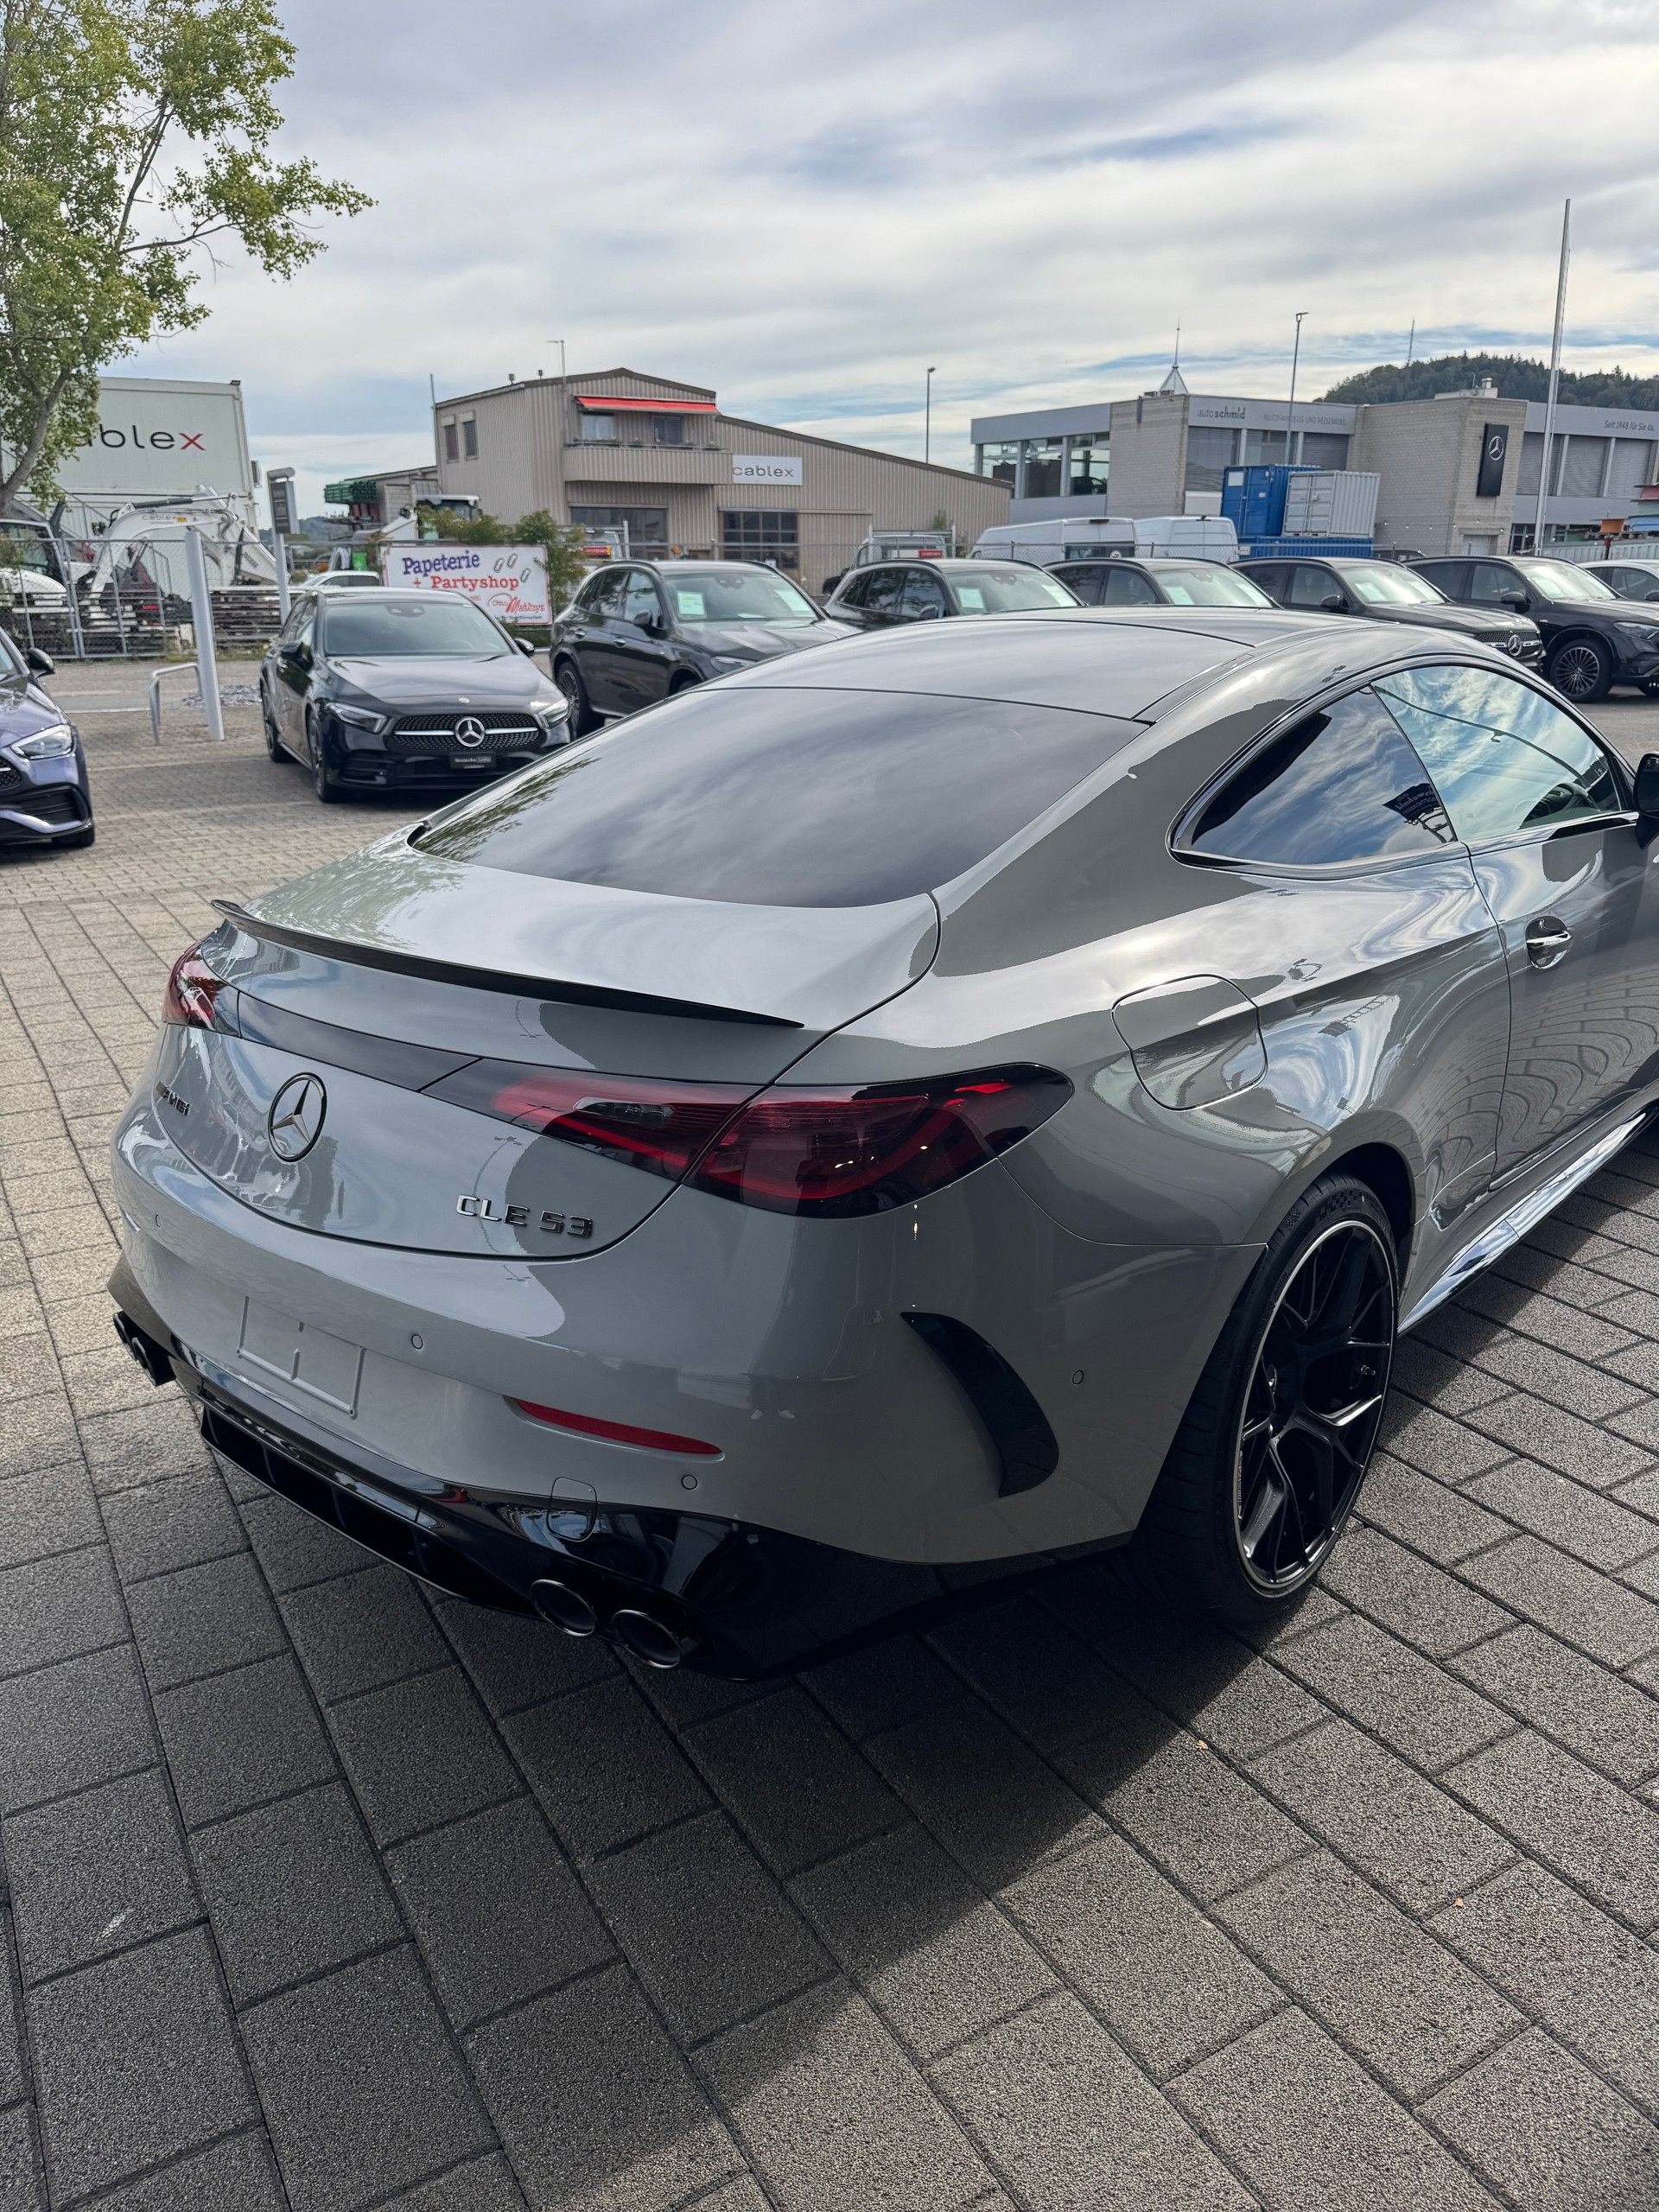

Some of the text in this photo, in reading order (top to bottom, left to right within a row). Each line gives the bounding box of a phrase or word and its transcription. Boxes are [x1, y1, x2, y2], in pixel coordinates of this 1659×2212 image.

[1605, 420, 1615, 429] Seit
[732, 466, 794, 477] cablex
[402, 550, 480, 576] Papeterie
[430, 575, 519, 592] Partyshop
[162, 1087, 190, 1116] AMG
[456, 1194, 594, 1238] CLE 53
